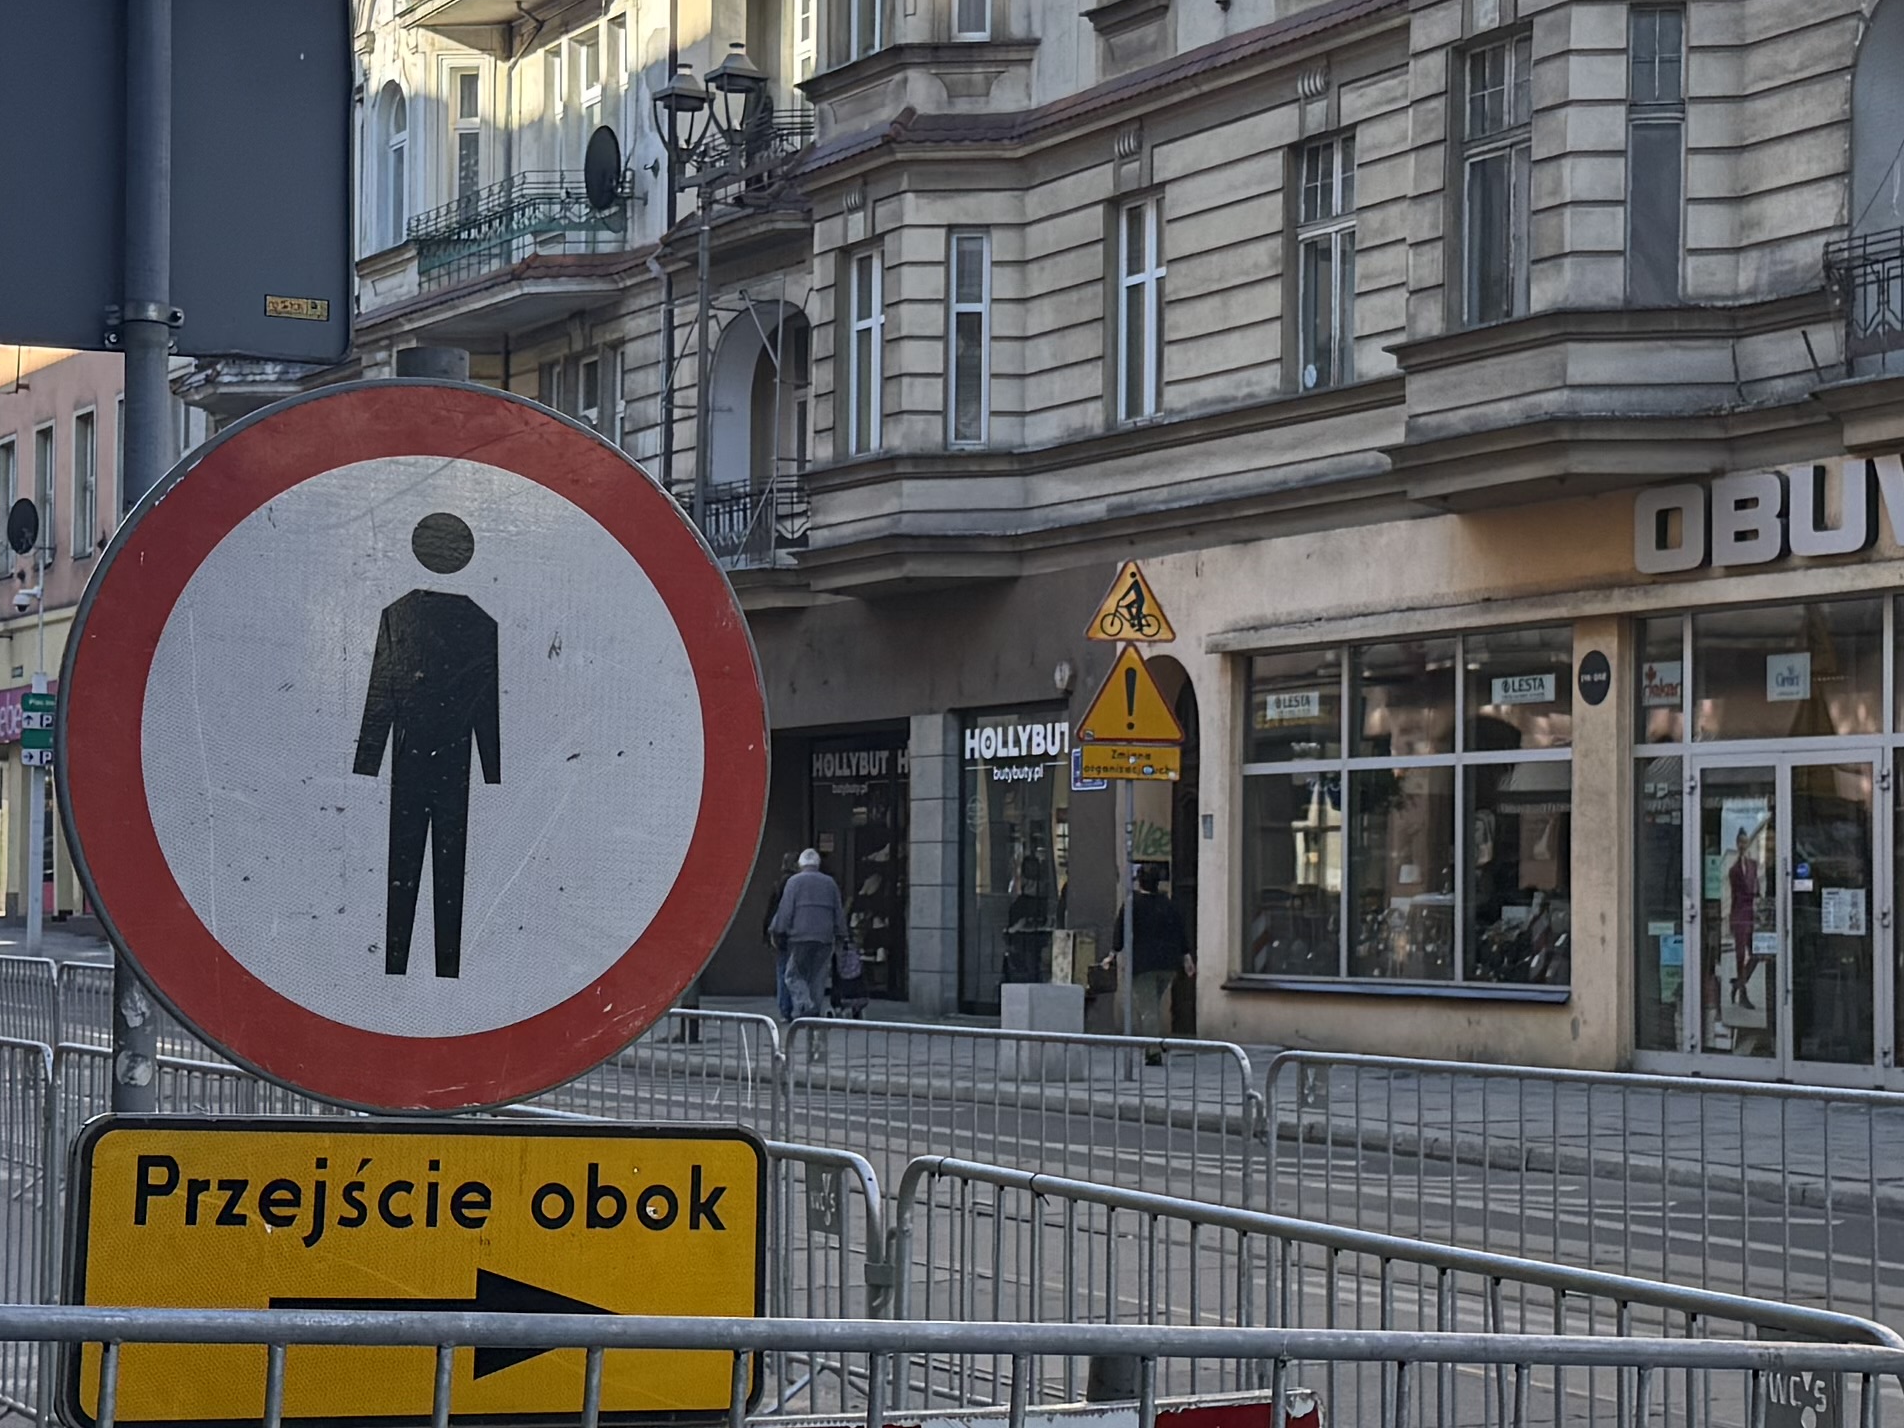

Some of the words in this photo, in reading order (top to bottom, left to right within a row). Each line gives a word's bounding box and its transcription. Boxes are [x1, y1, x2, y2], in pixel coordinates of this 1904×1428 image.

[813, 751, 889, 777] HOLLYBUT
[133, 1153, 492, 1247] Przejście
[532, 1162, 727, 1231] obok
